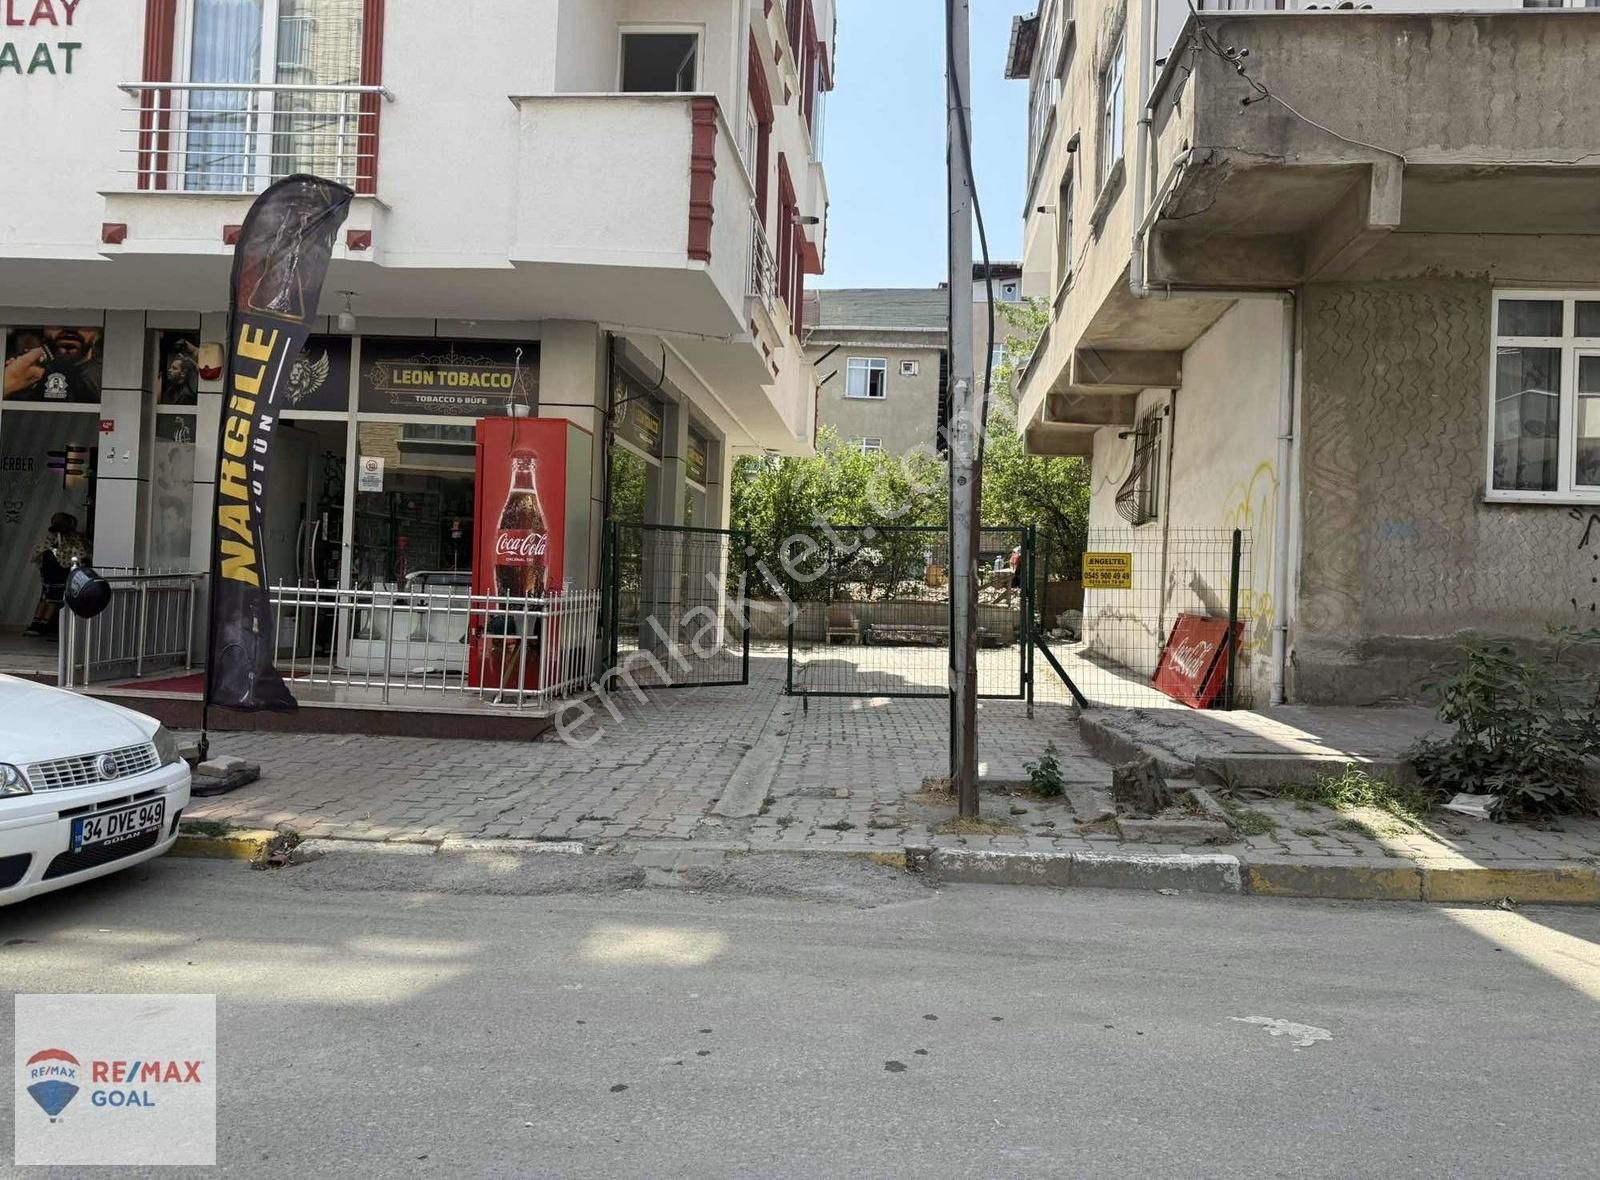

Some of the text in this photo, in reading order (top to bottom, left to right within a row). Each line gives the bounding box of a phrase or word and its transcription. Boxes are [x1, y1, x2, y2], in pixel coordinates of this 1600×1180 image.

[393, 369, 512, 388] LEON TOBACCO
[415, 395, 455, 404] TOBACCO
[456, 396, 464, 404] &
[1, 456, 34, 473] ERBER
[1085, 572, 1099, 580] 0545
[83, 818, 102, 841] 34
[107, 810, 137, 837] DVE
[139, 802, 162, 827] 949
